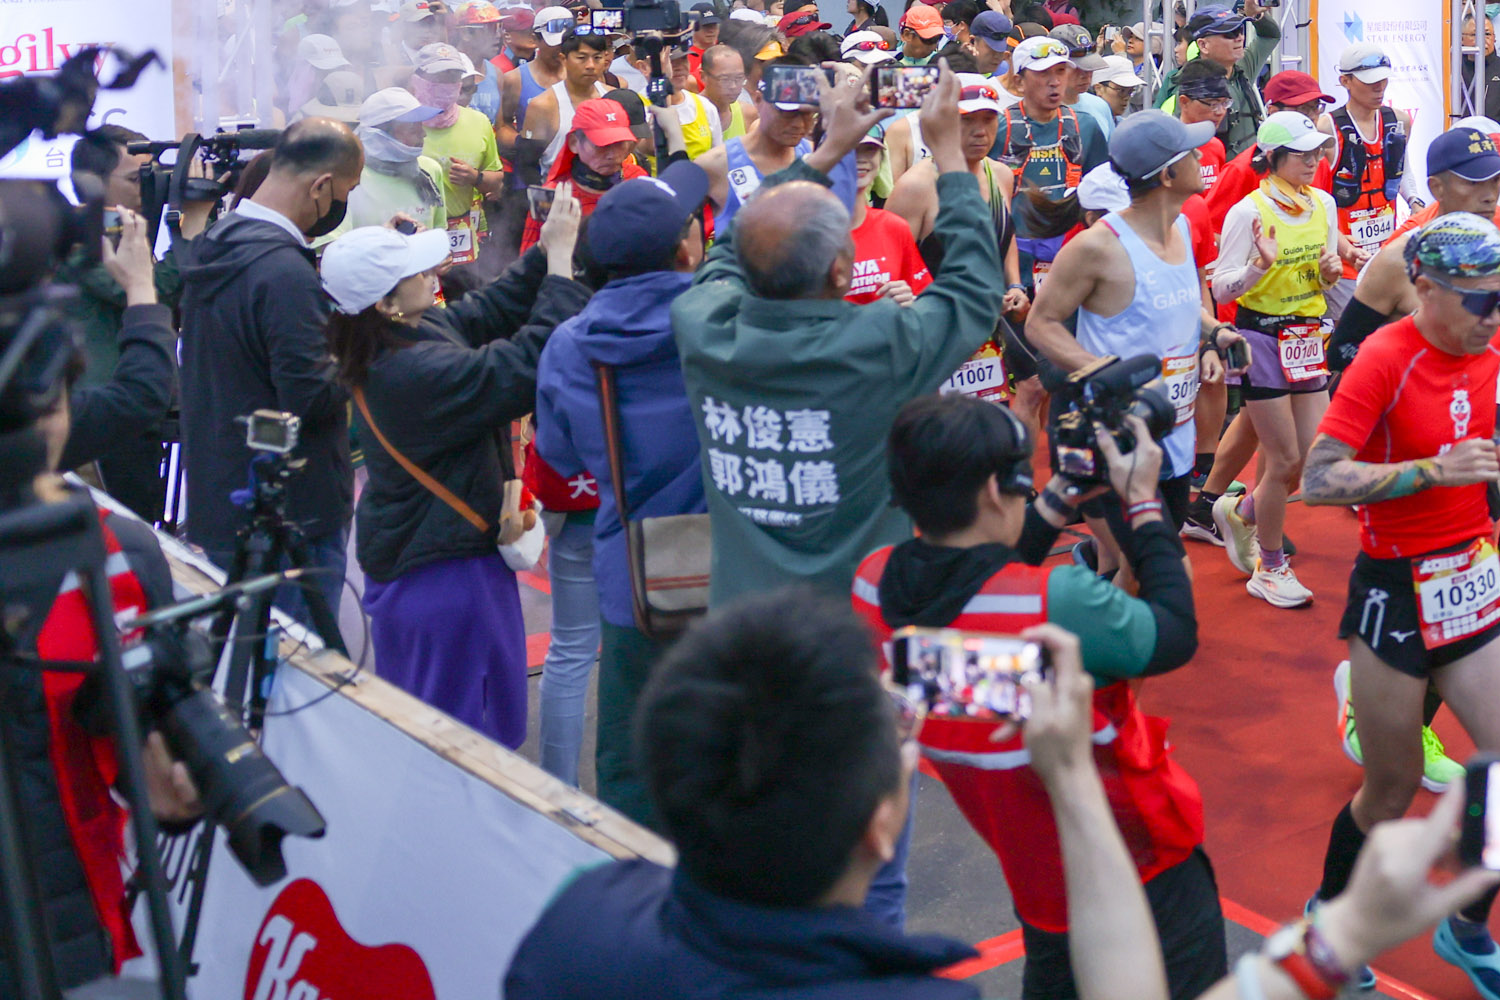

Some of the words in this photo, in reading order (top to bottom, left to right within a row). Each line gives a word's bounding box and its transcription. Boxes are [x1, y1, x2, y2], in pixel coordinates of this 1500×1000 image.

[1367, 34, 1389, 43] STAR
[1392, 33, 1427, 42] ENERGY
[1357, 221, 1391, 239] 10944
[1283, 246, 1303, 256] Guide
[1153, 287, 1199, 310] GARM
[702, 396, 834, 452] 林俊憲
[708, 448, 839, 505] 郭鴻儀
[1434, 568, 1496, 609] 10330
